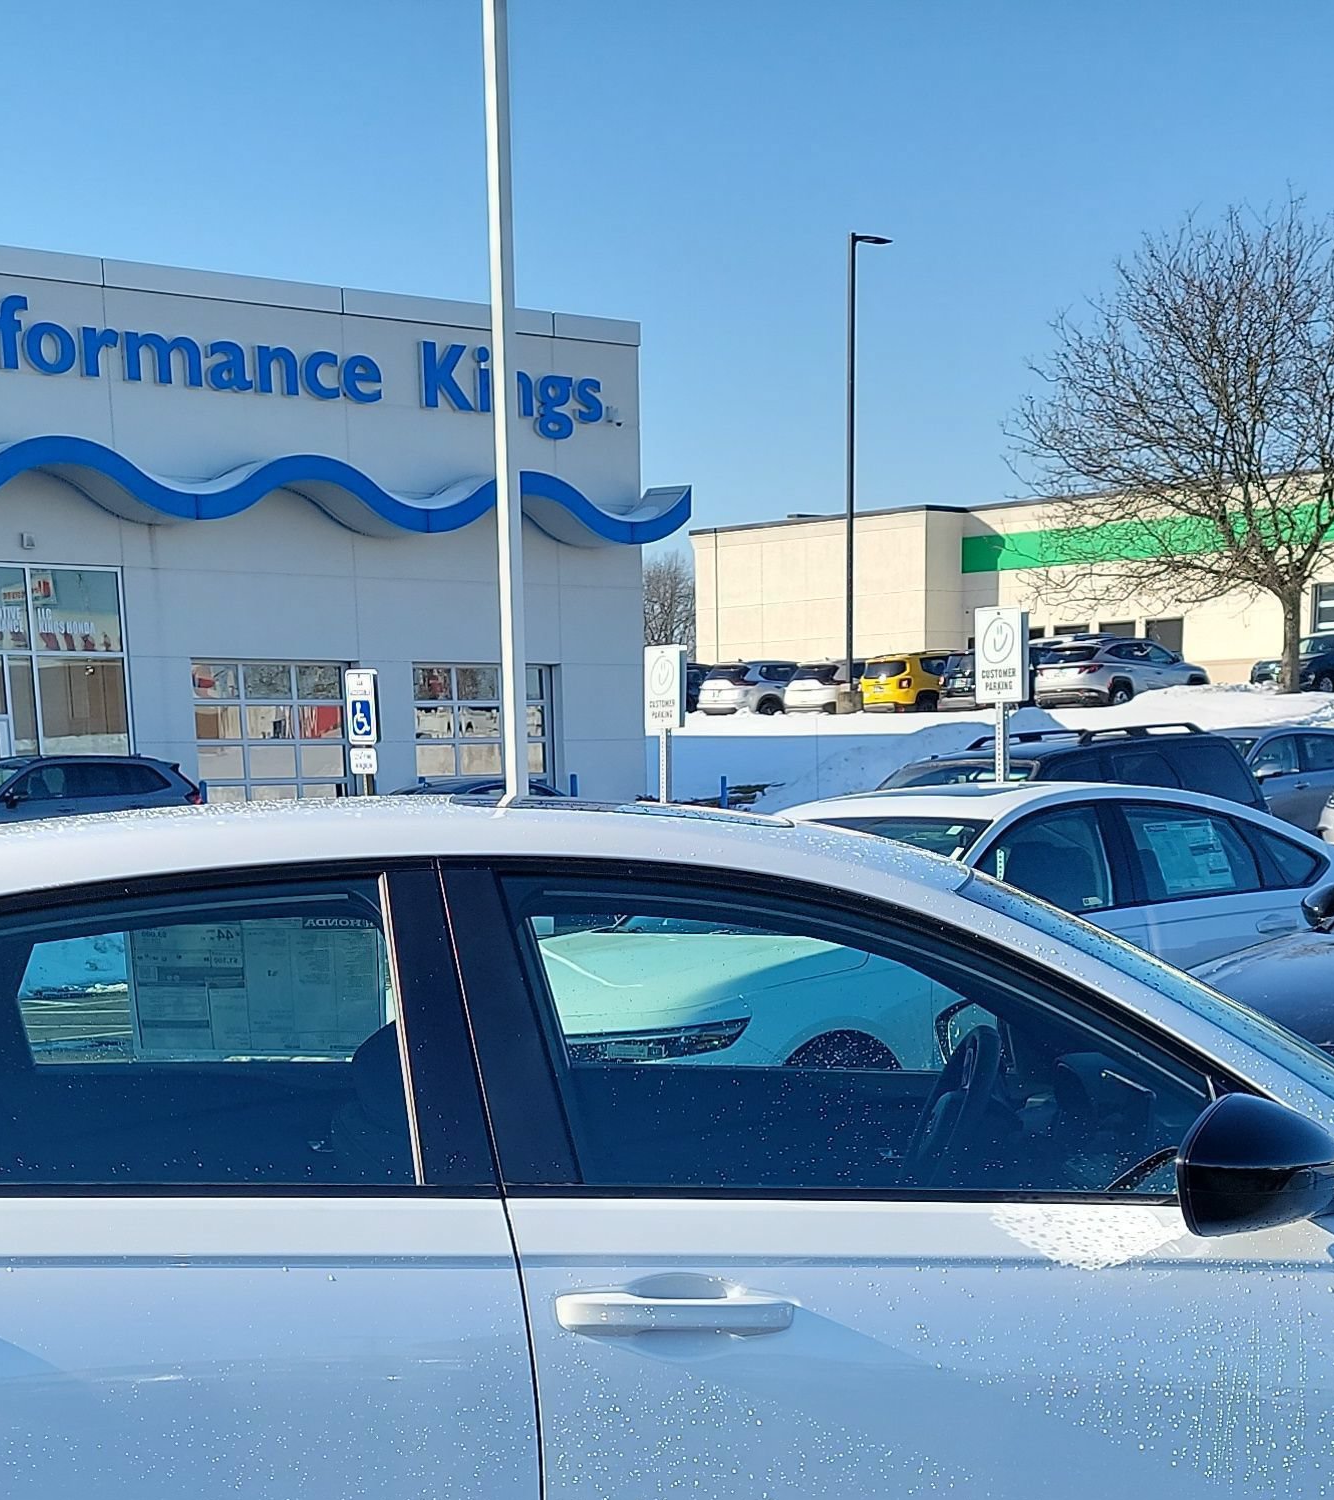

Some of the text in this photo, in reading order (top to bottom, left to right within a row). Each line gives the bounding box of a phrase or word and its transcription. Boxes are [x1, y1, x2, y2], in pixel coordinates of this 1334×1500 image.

[417, 340, 604, 441] Kings
[37, 607, 53, 620] LLC
[38, 620, 66, 634] KINGS
[66, 621, 96, 635] HONDA
[981, 667, 1016, 679] CUSTOMER
[985, 680, 1013, 691] PARKING
[649, 699, 676, 708] CUSTOMER
[651, 710, 673, 719] PARKING
